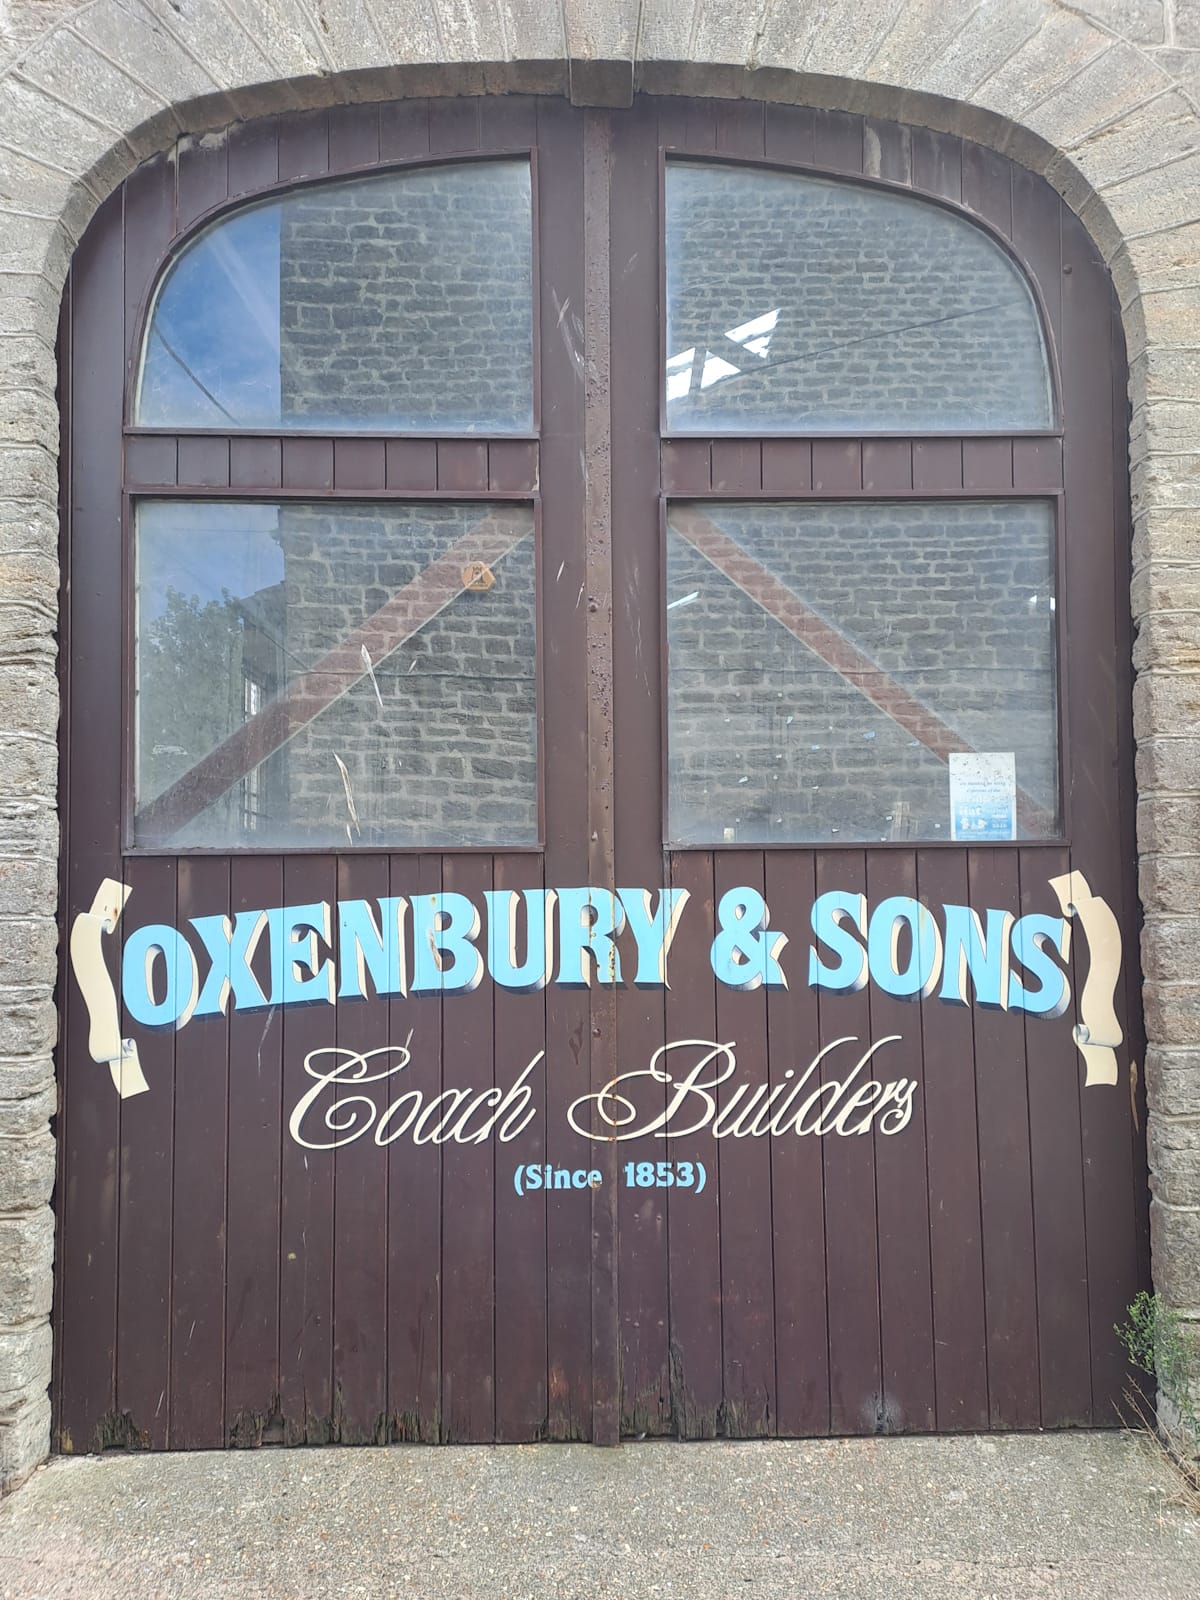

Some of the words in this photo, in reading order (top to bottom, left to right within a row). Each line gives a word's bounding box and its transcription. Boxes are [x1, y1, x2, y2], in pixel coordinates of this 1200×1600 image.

[122, 886, 691, 1029] OXENBURY
[711, 887, 789, 991] &
[808, 890, 1072, 1017] SONS
[290, 1046, 545, 1150] Coach
[567, 1035, 917, 1141] Builders
[513, 1163, 603, 1197] (Since
[624, 1161, 707, 1194] 1853)
